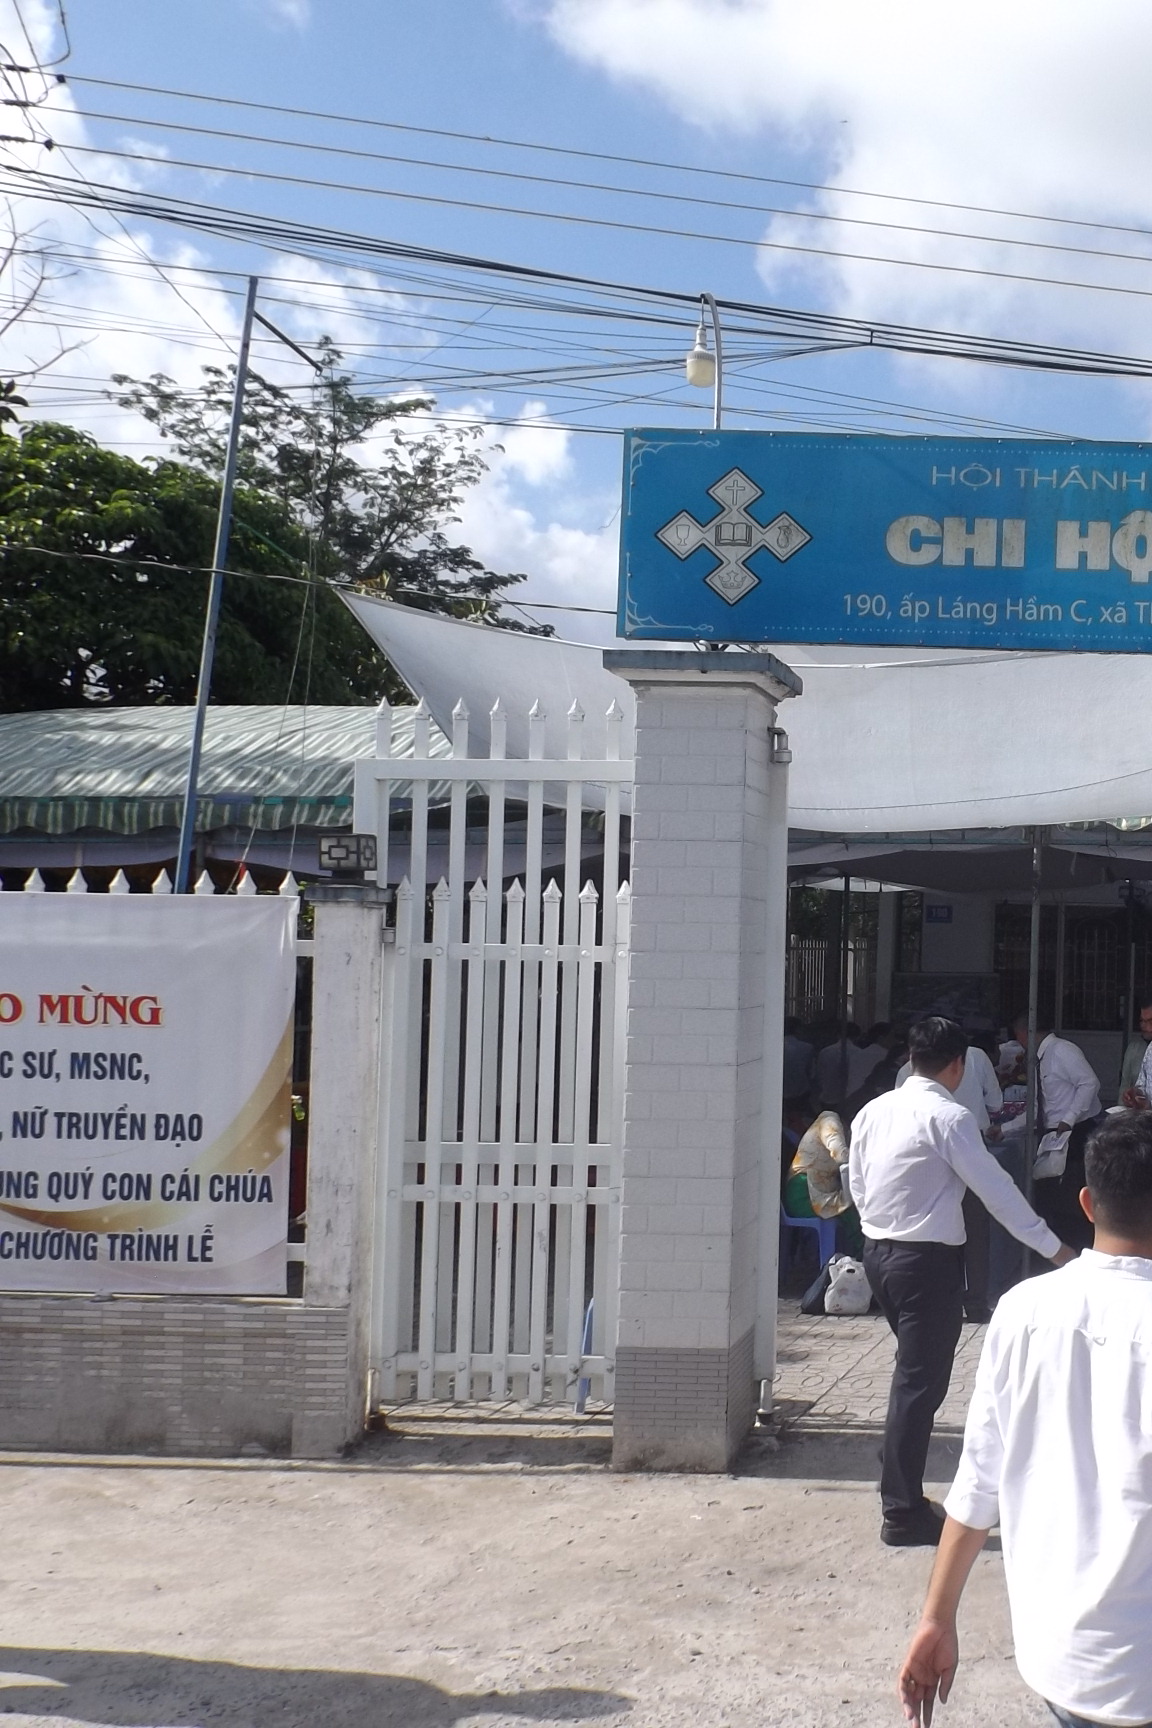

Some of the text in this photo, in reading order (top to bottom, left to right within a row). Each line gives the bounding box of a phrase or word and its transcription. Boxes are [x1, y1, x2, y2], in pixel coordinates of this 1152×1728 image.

[931, 463, 1001, 491] HỘI
[1014, 465, 1146, 491] THÁNH
[886, 515, 1026, 568] CHI
[843, 594, 892, 620] 190,
[900, 592, 930, 623] ấp
[938, 596, 997, 625] Láng
[1006, 596, 1063, 621] Hầm
[1070, 600, 1093, 626] C,
[1100, 601, 1128, 623] xã
[38, 984, 162, 1025] MỪNG
[22, 1049, 61, 1083] SƯ,
[70, 1052, 150, 1084] MSNC,
[12, 1106, 48, 1139] NỮ
[154, 1114, 203, 1147] ĐẠO
[47, 1166, 95, 1203] QUÝ
[102, 1173, 152, 1201] CON
[160, 1168, 200, 1202] CÁI
[208, 1169, 273, 1202] CHÚA
[0, 1225, 214, 1262] CHƯƠNG TRÌNH LỄ
